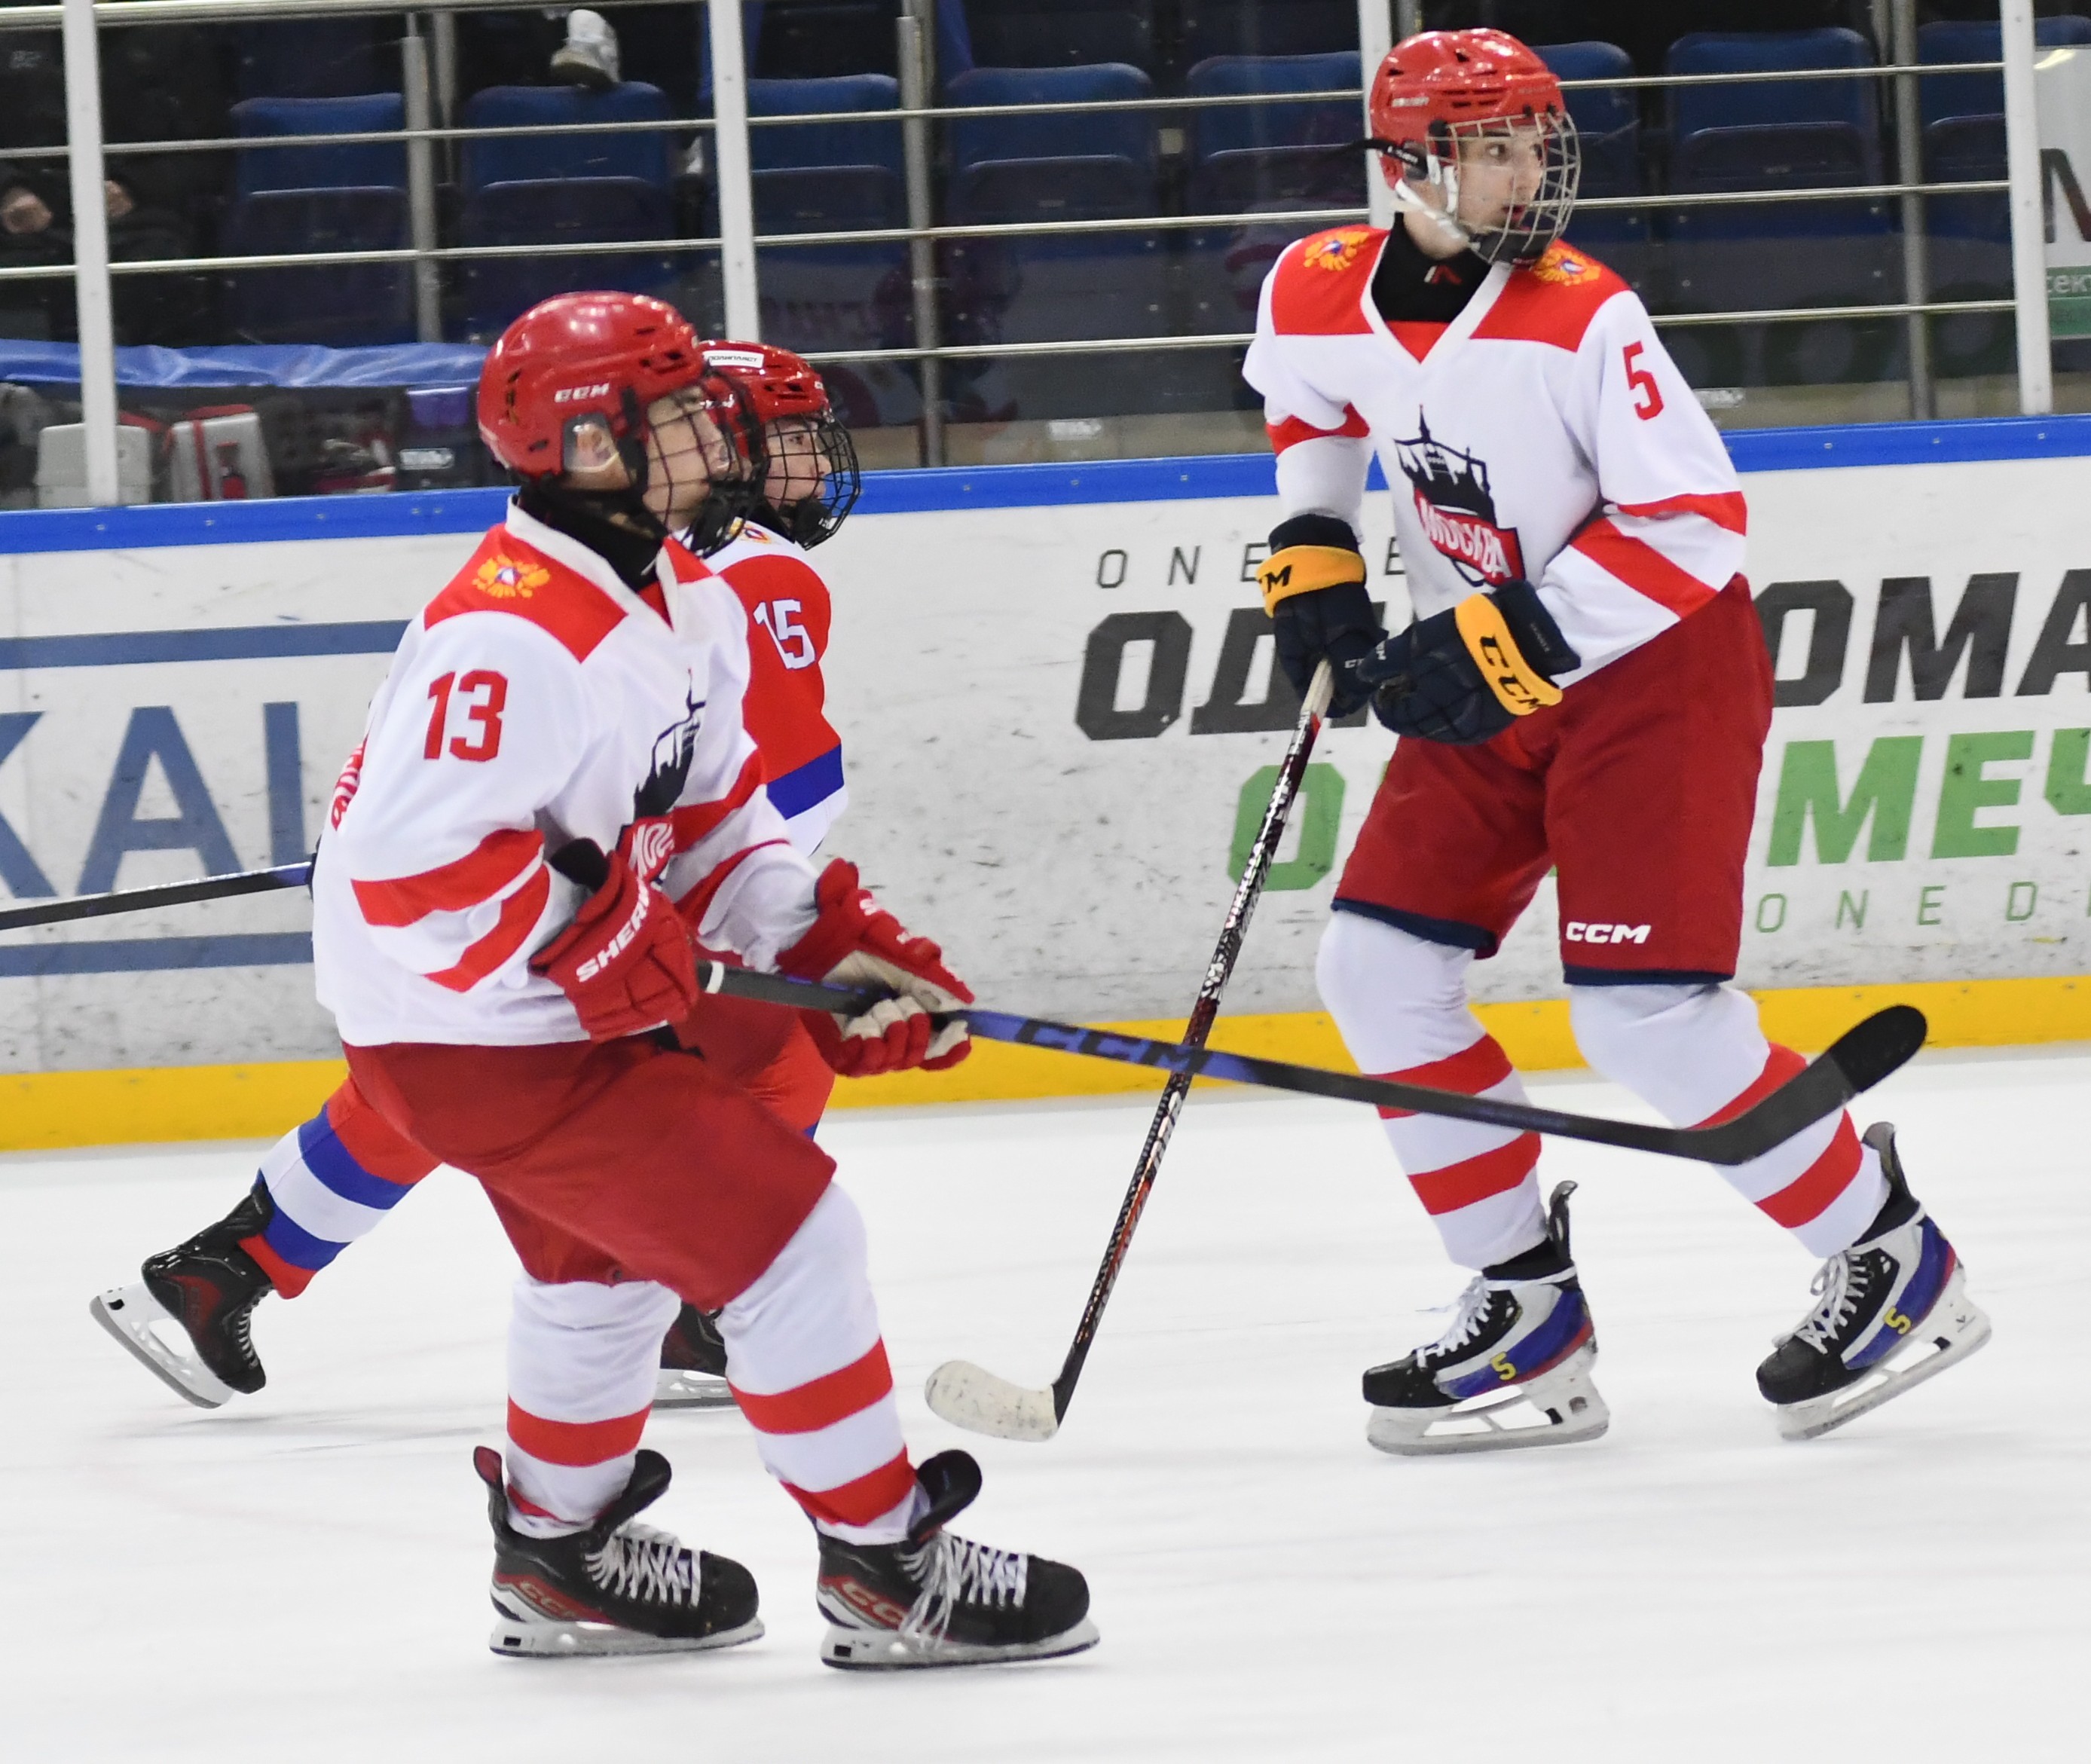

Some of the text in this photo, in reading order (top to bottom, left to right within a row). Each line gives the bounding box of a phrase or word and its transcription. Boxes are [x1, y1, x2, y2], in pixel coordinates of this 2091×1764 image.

[555, 383, 610, 403] CCM
[1622, 341, 1665, 420] 5
[1419, 497, 1512, 579] МОСКВА
[754, 598, 816, 670] 15
[423, 668, 509, 763] 13
[1566, 922, 1652, 943] CCM
[1015, 1019, 1213, 1074] CCM
[1885, 1307, 1912, 1334] 5
[1490, 1351, 1517, 1380] 5
